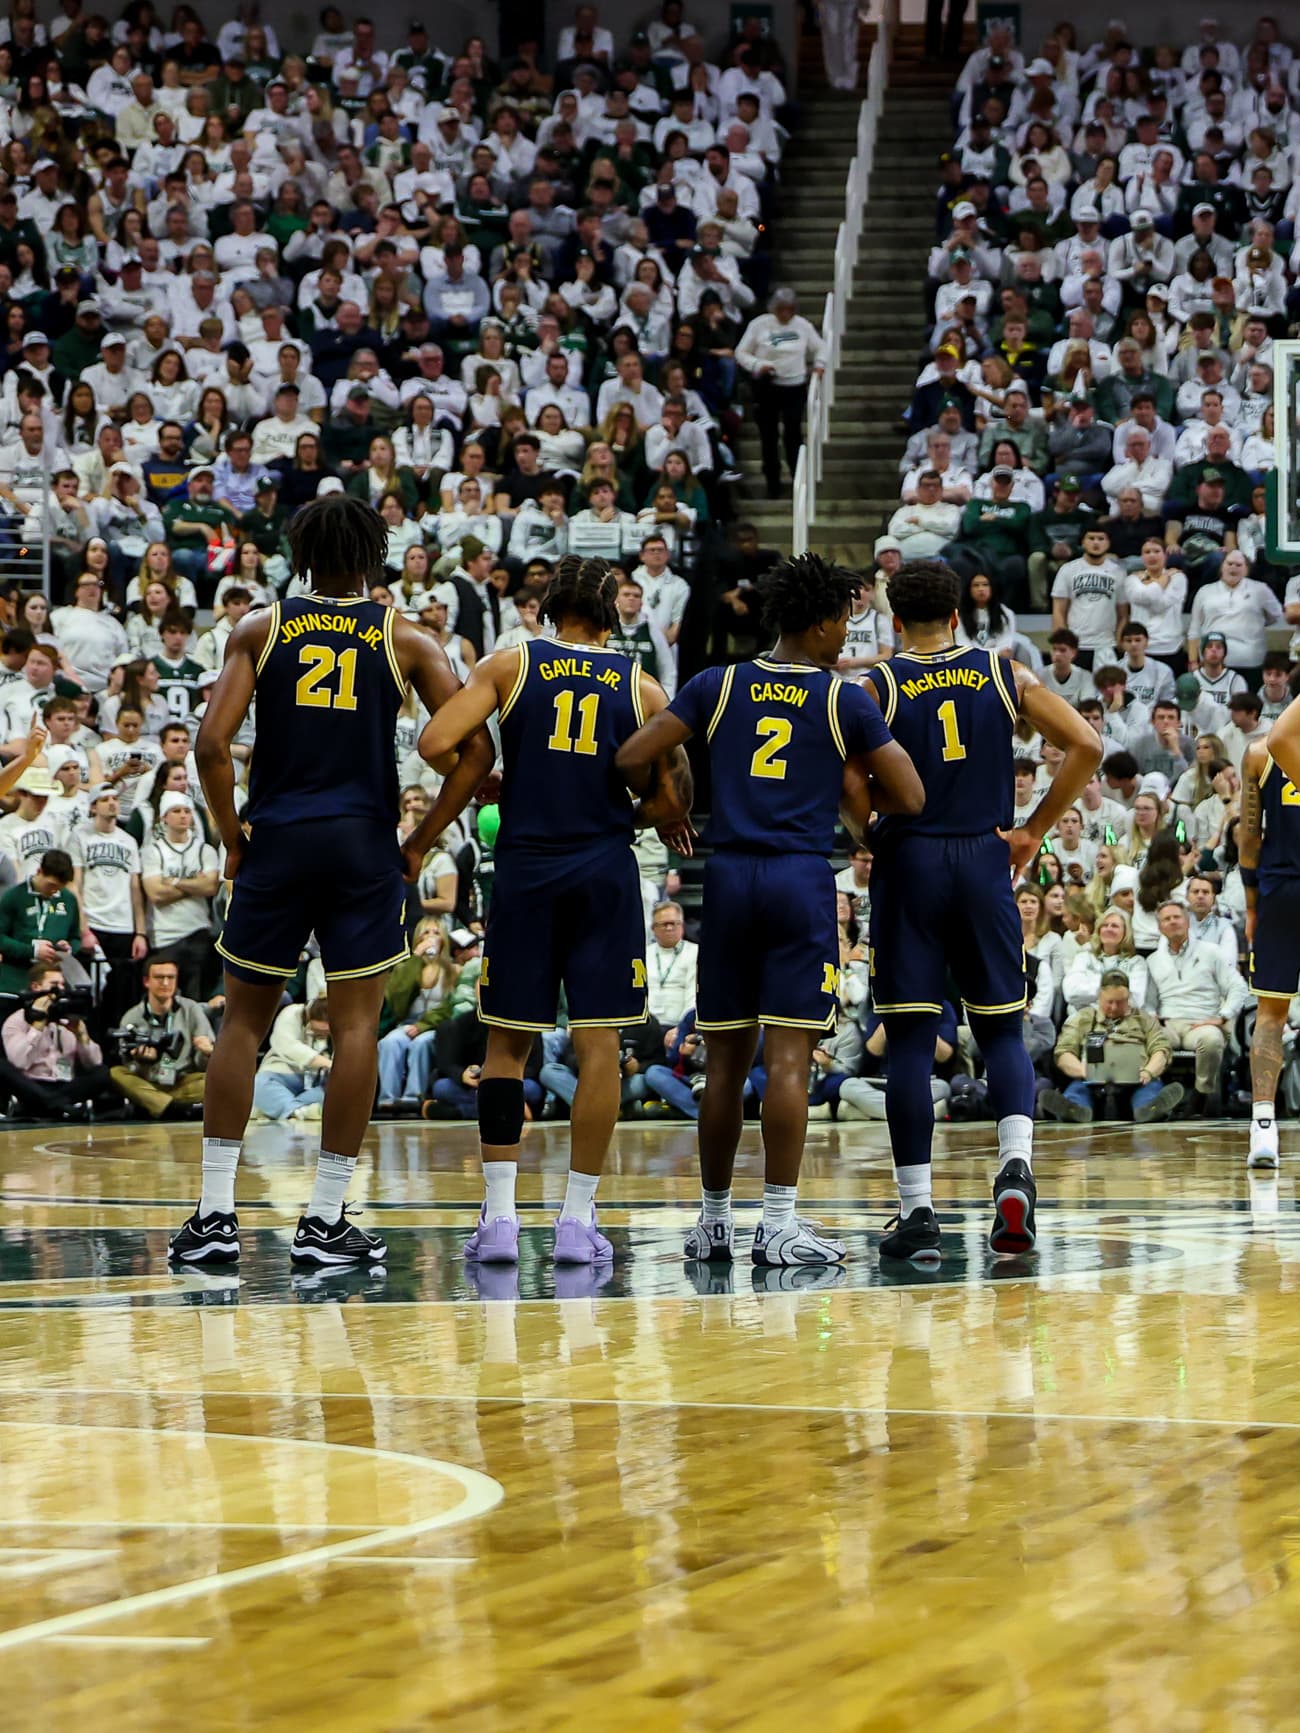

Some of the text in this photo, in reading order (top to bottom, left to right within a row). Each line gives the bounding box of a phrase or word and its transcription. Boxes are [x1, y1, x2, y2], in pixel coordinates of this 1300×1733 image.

[280, 612, 383, 651] JOHNSON JR.
[295, 643, 358, 710] 21
[539, 658, 622, 692] GAYLE JR.
[750, 682, 809, 707] CASON
[900, 668, 990, 701] McKENNEY
[547, 689, 600, 756] 11
[749, 716, 793, 780] 2
[936, 699, 967, 762] 1
